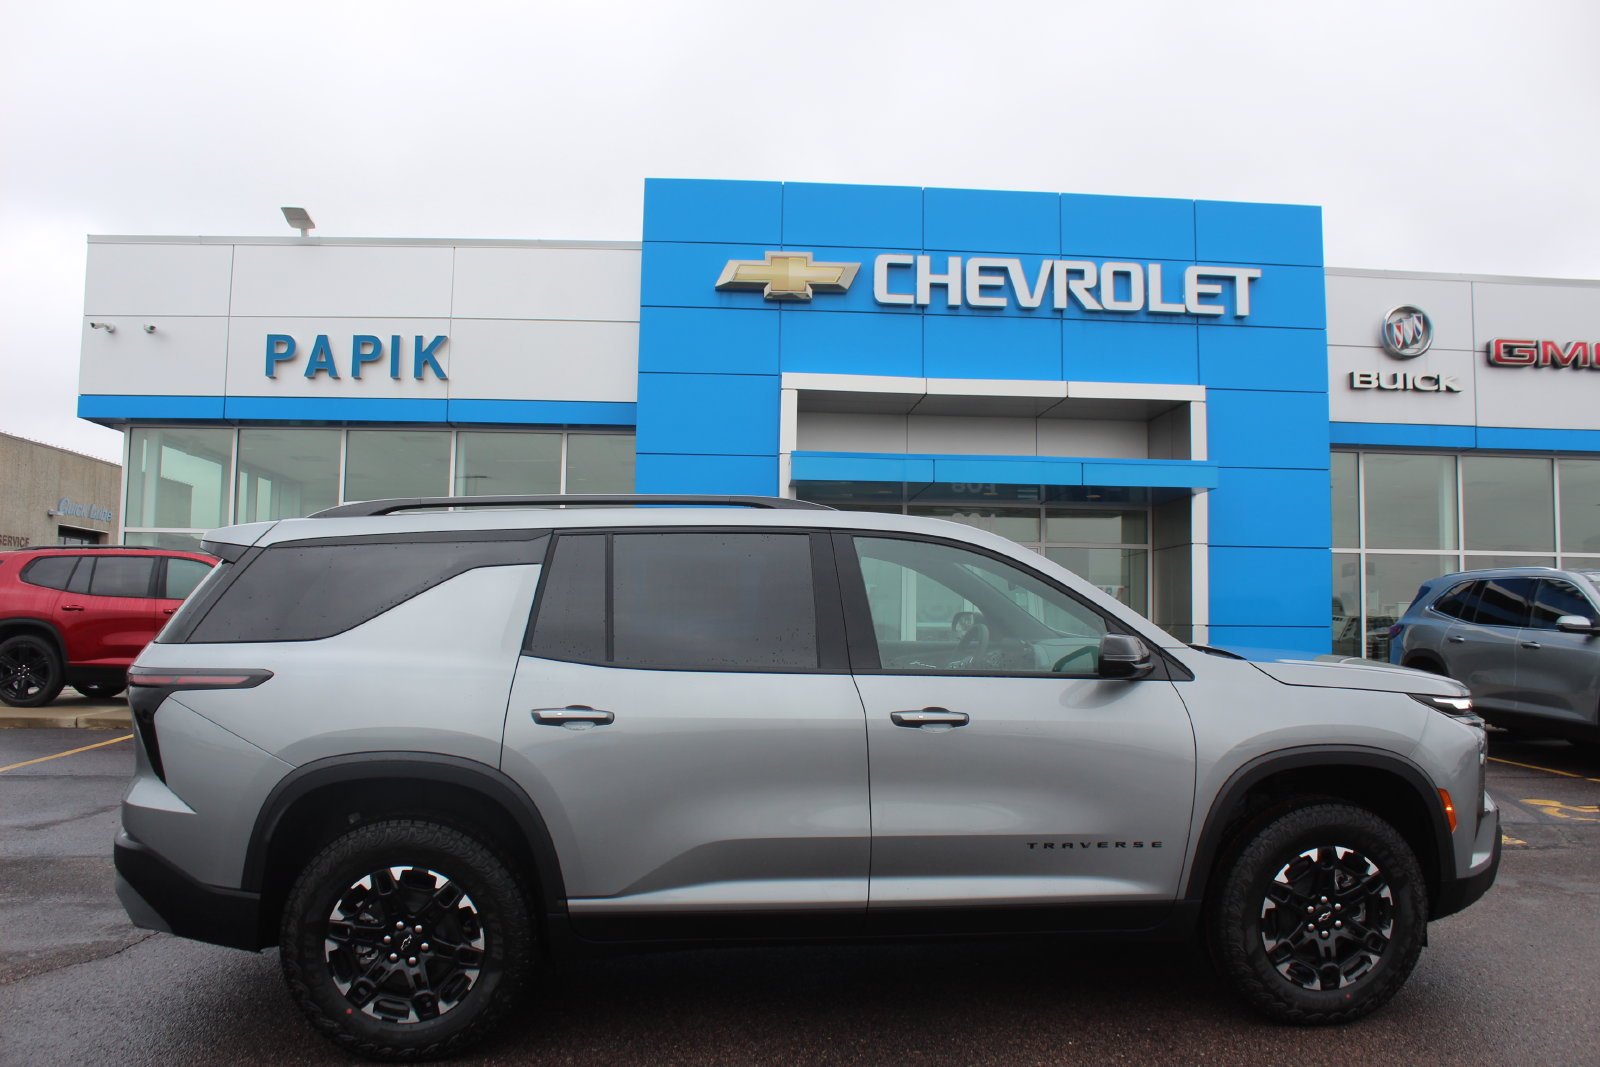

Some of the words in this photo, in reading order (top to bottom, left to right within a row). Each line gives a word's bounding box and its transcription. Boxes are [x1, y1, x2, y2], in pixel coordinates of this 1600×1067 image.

[873, 253, 1262, 319] CHEVROLET
[265, 333, 450, 380] PAPIK
[1348, 371, 1464, 392] BUICK
[1026, 841, 1163, 850] TRAVERSE
